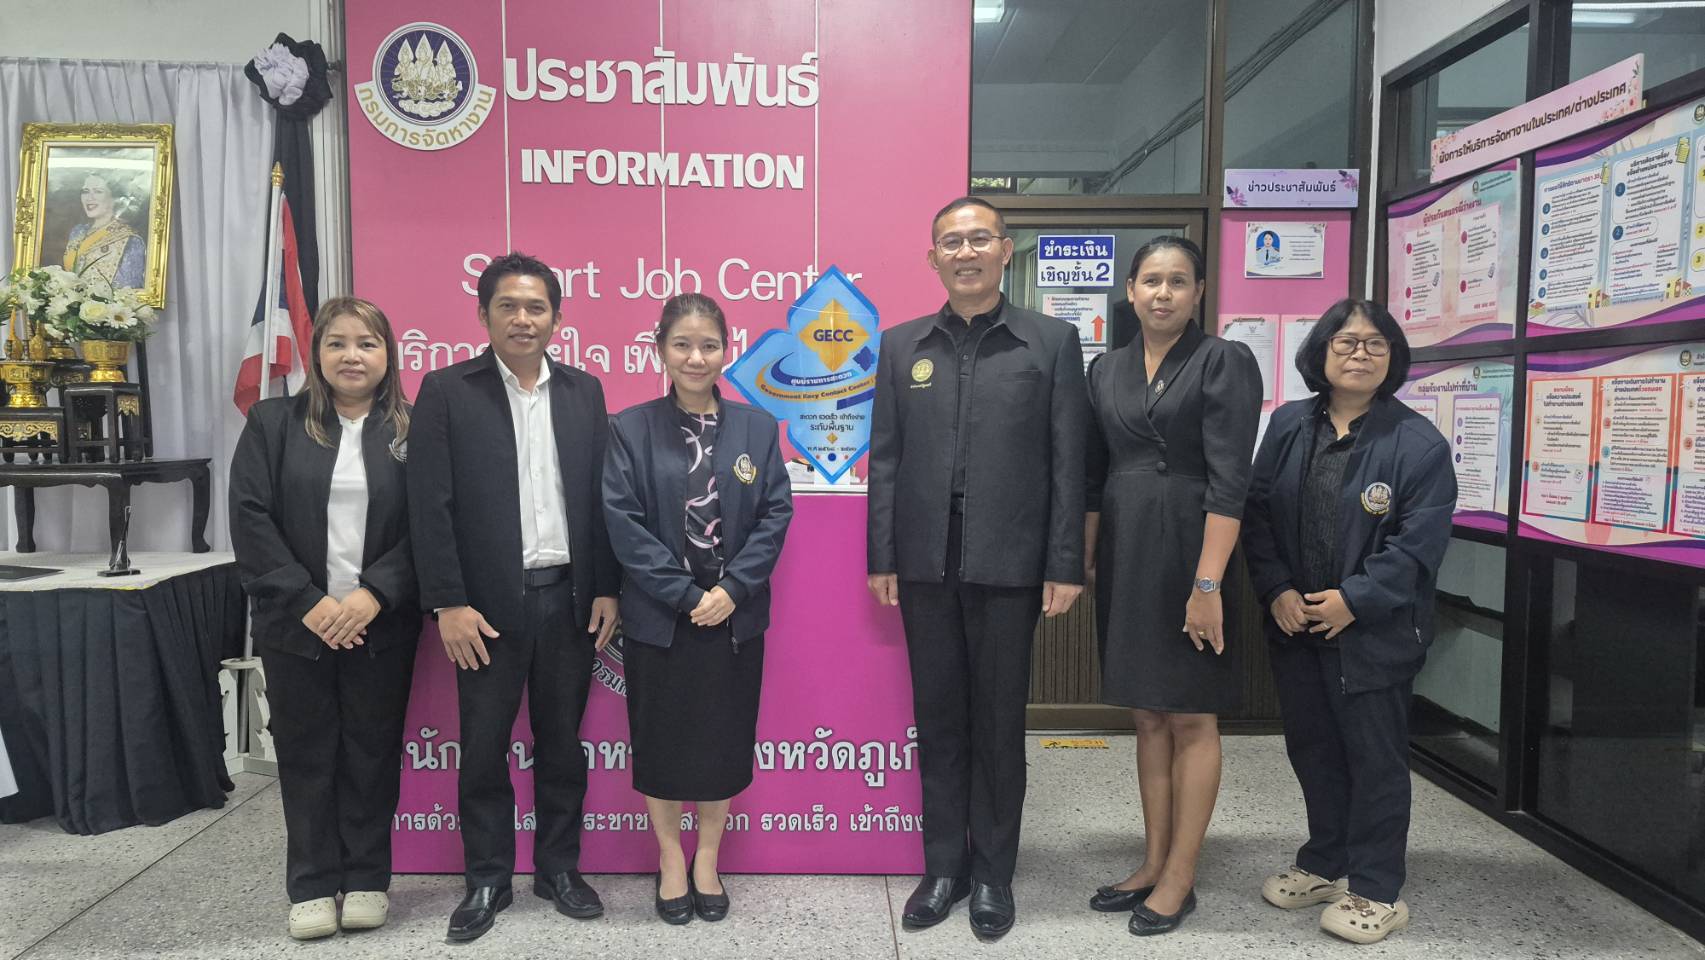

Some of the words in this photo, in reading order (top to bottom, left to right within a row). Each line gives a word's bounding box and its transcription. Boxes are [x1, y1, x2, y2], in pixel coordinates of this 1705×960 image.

[505, 46, 820, 107] ประชาสัมพันธ์
[358, 87, 493, 147] กรมการจัดหางาน
[521, 148, 804, 189] INFORMATION
[1247, 180, 1337, 192] ข่าวประชาสัมพันธ์
[1044, 240, 1109, 257] ชำระเงิน
[461, 253, 600, 299] Sart
[619, 257, 702, 300] Job
[718, 257, 863, 301] Centr
[1041, 261, 1094, 284] เชิญชั้น
[1096, 262, 1110, 282] 2
[813, 329, 854, 342] GECC
[760, 804, 838, 832] รวดเร็ว
